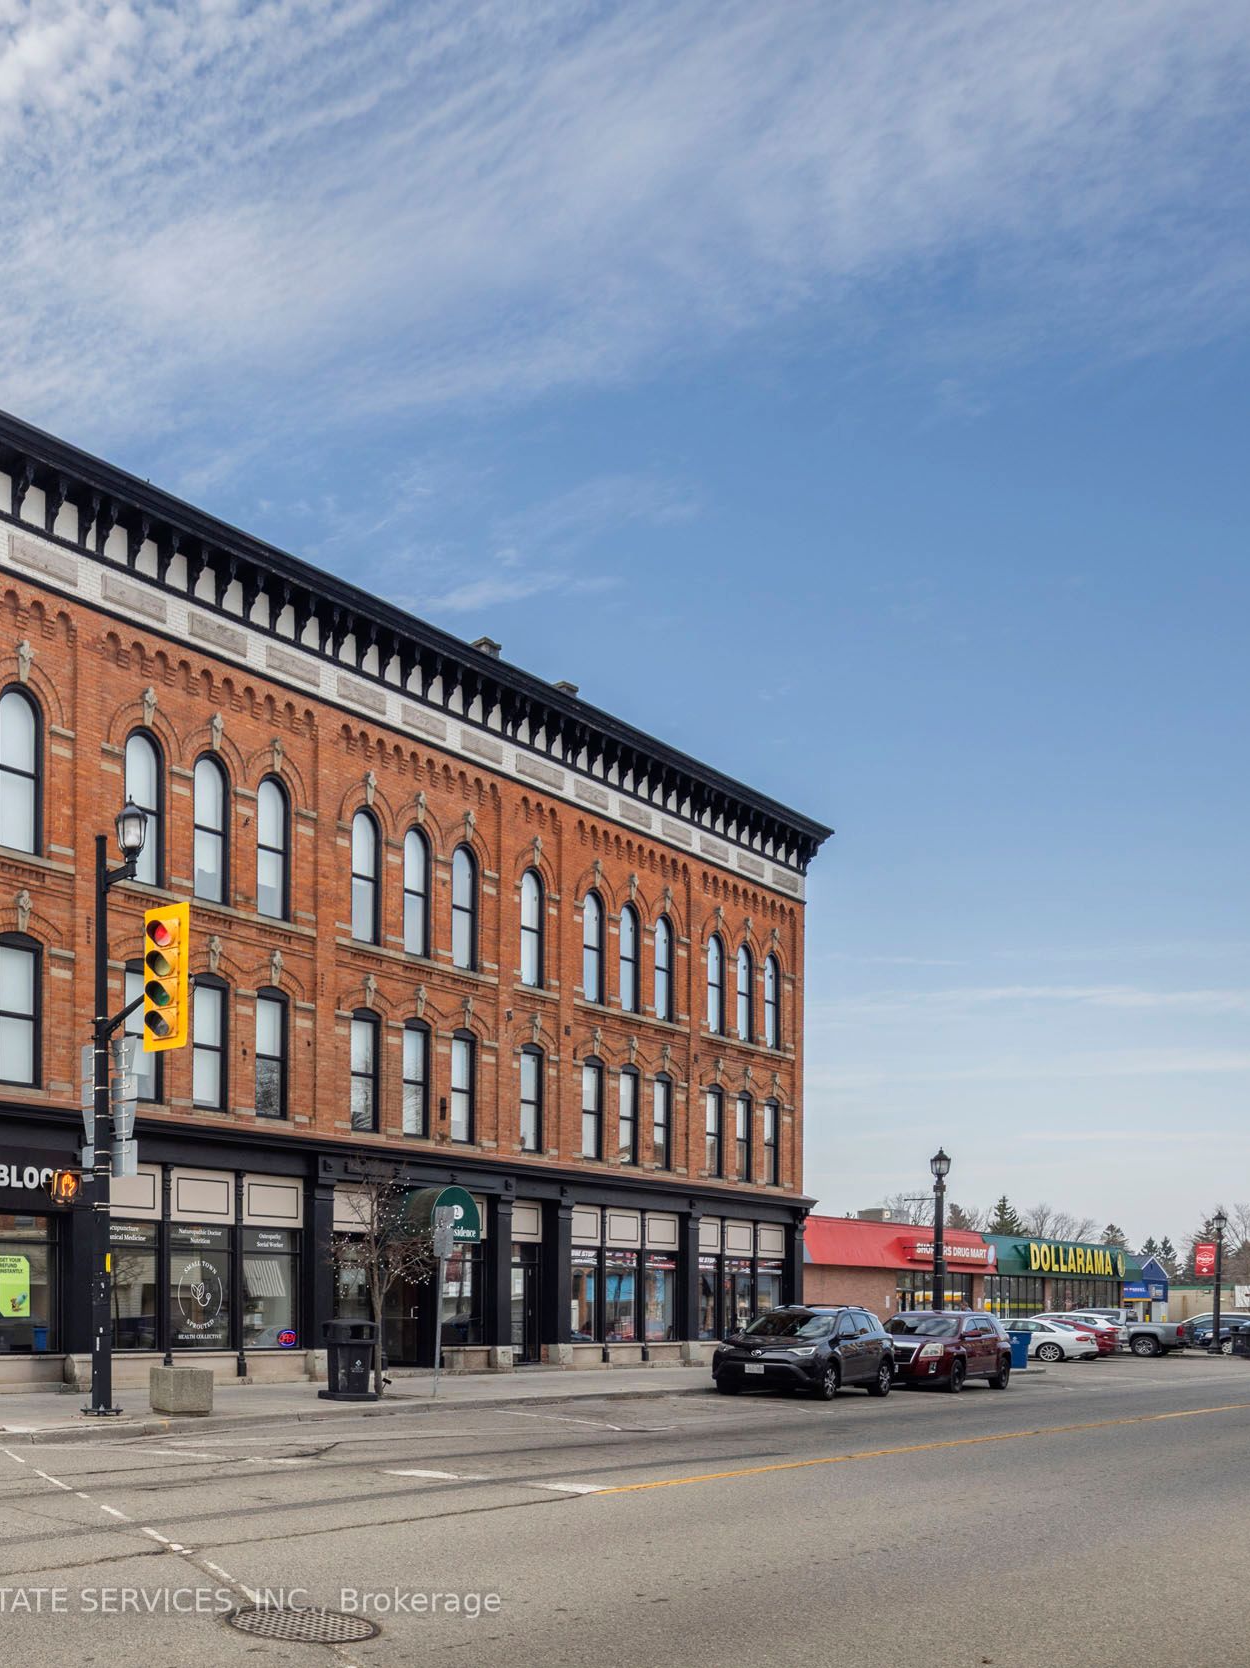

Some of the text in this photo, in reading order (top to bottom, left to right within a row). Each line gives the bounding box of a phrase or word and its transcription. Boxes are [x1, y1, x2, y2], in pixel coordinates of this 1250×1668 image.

[110, 1224, 139, 1232] cupuncture
[178, 1227, 206, 1236] Naturopathic
[454, 1225, 477, 1238] sidence
[124, 1233, 147, 1241] Medicine
[190, 1236, 211, 1244] Nutrition
[258, 1233, 282, 1241] Osteopathy
[952, 1246, 970, 1258] DRUG
[970, 1248, 987, 1259] MART
[1030, 1242, 1113, 1276] DOLLARAMA
[184, 1260, 217, 1275] SMALL TOWN
[186, 1318, 215, 1330] SPROUTED
